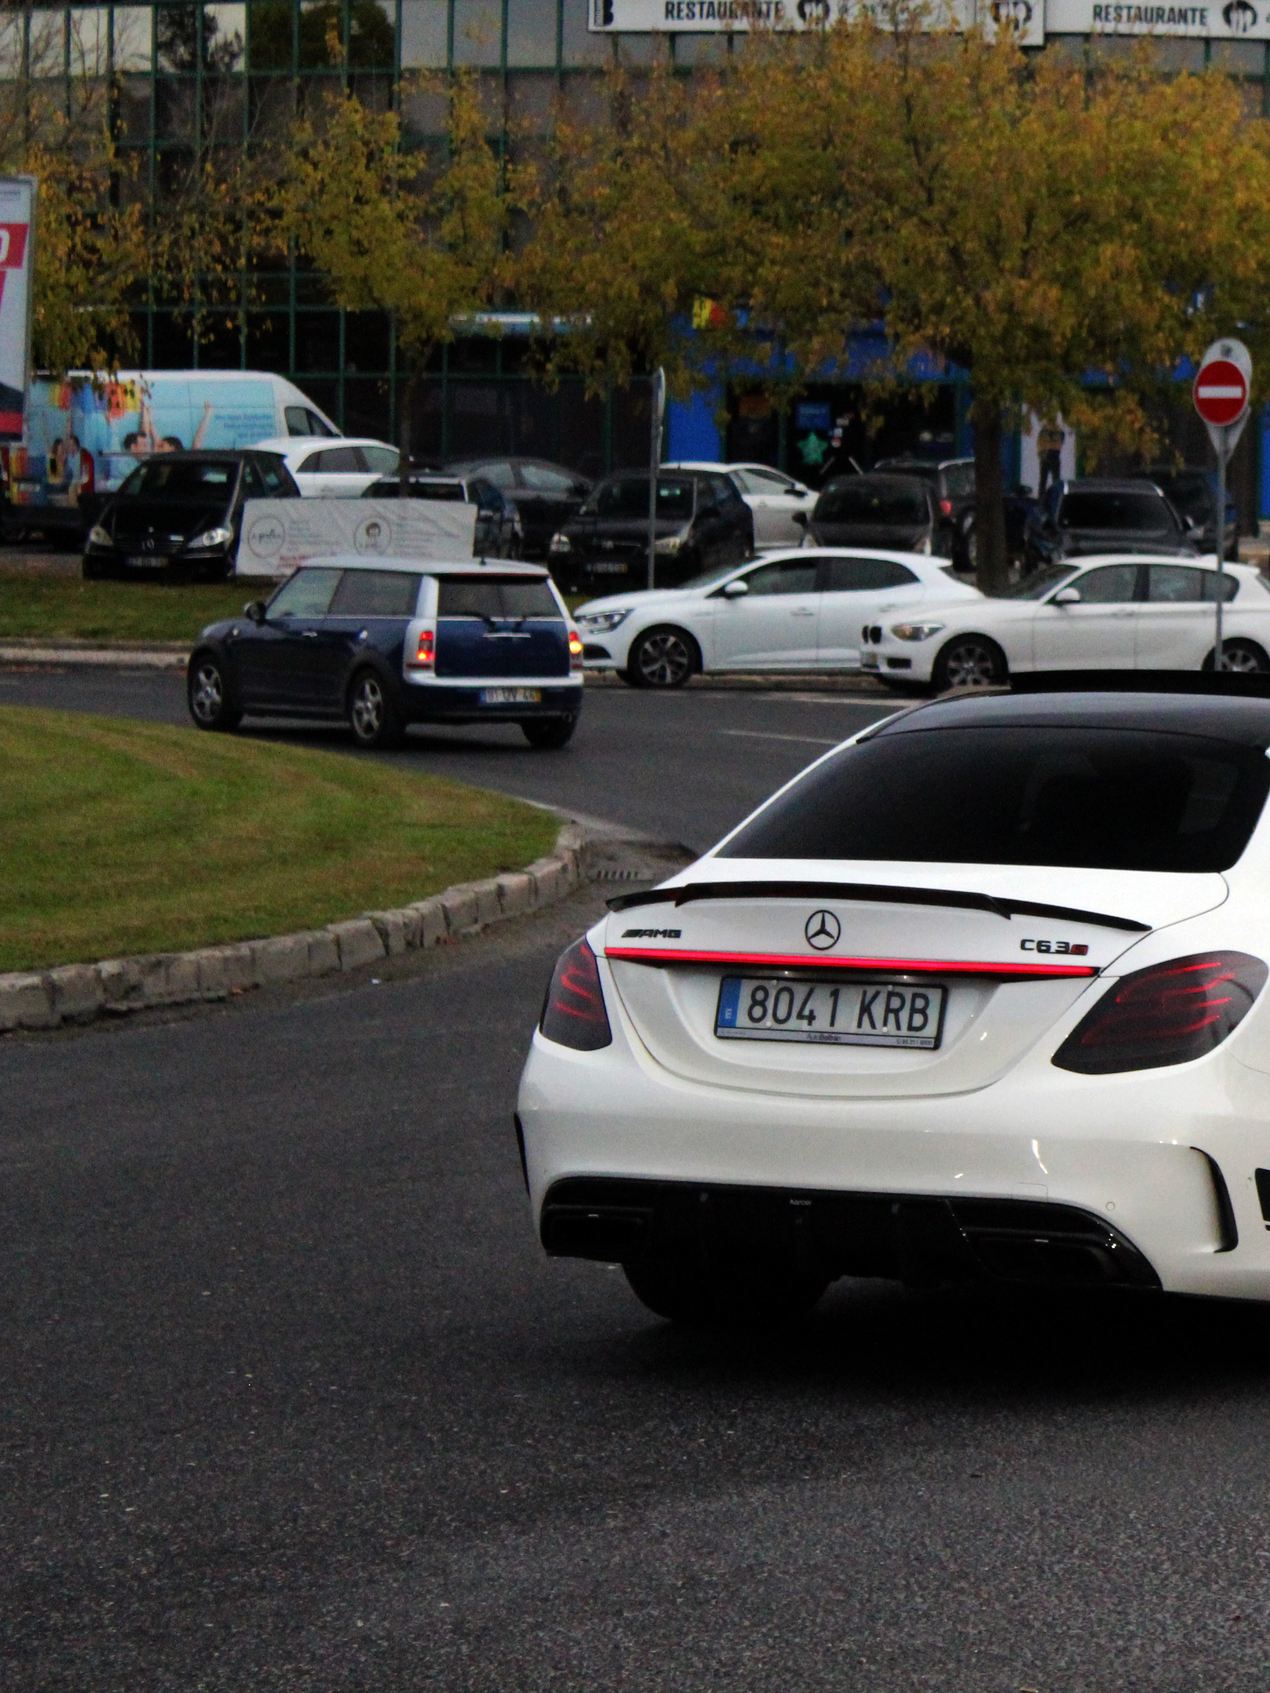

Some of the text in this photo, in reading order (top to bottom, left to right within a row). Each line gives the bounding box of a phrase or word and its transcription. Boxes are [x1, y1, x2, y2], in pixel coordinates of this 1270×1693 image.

[1092, 4, 1208, 26] RESTAURANTE
[638, 929, 682, 939] AMG
[747, 985, 930, 1033] 8041 KRB
